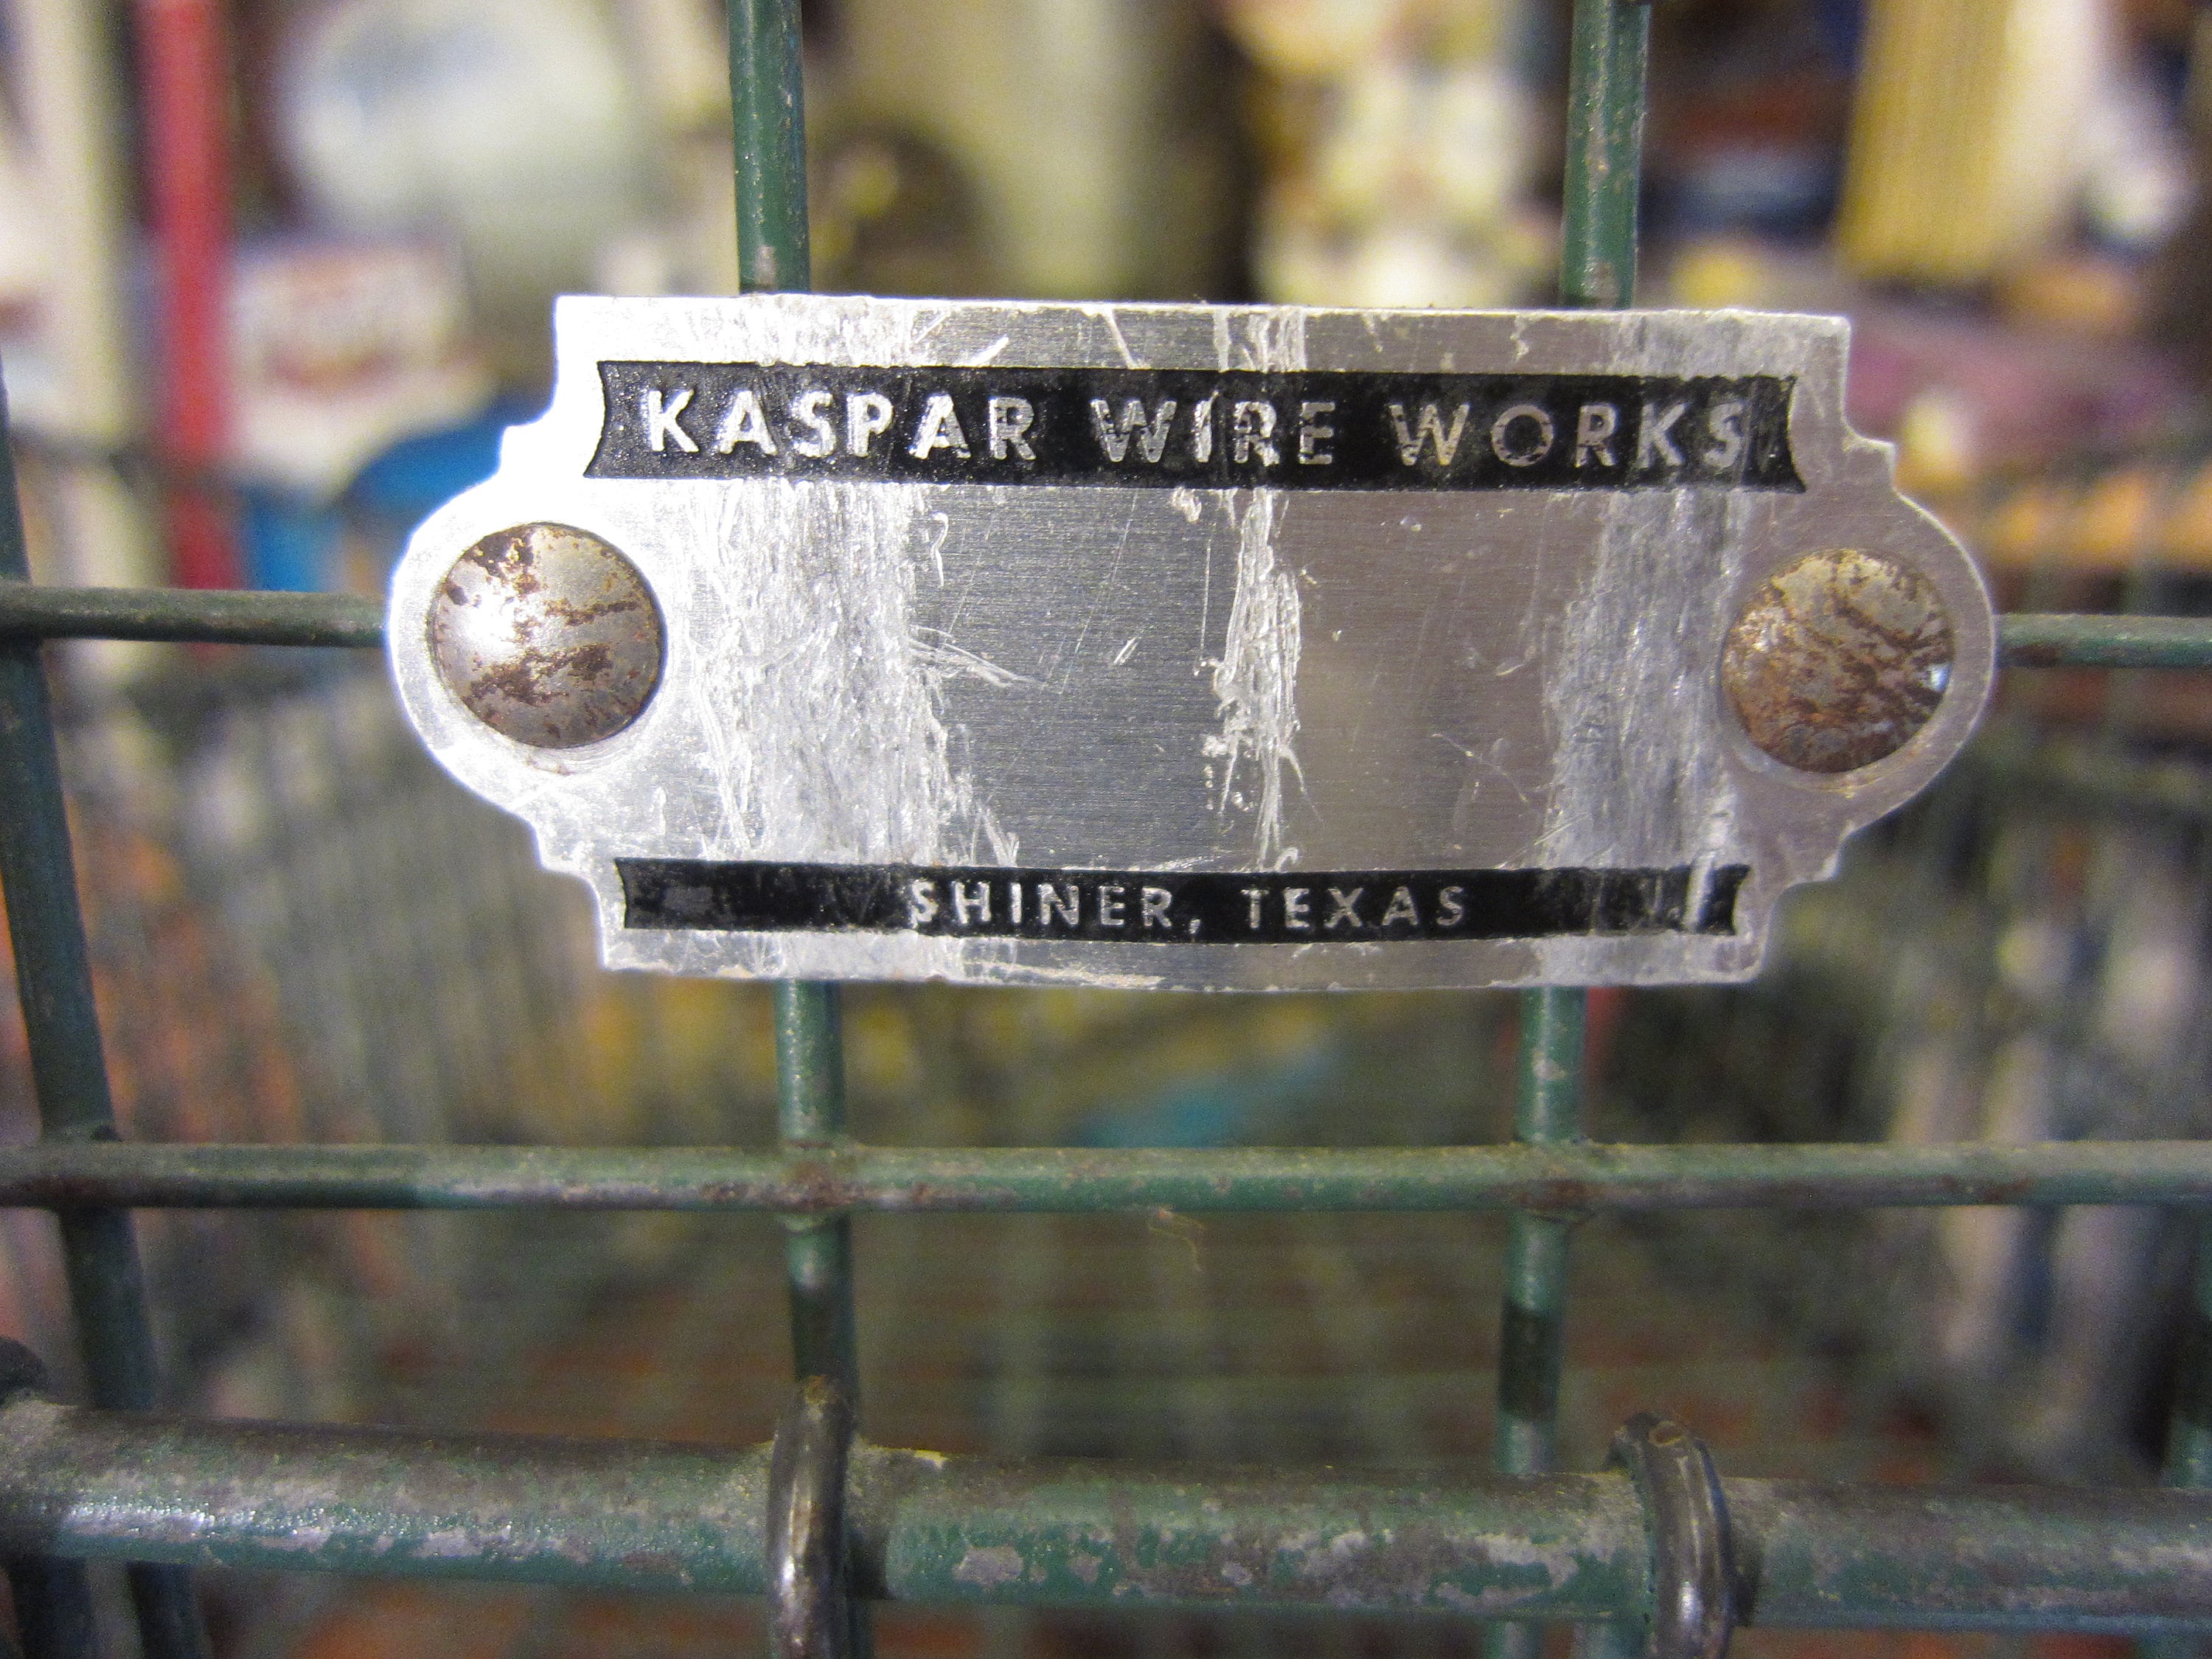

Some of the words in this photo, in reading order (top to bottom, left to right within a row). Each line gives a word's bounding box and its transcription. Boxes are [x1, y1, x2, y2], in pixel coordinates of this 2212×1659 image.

[646, 388, 1036, 461] KASPAR
[1090, 397, 1335, 466] WIRE
[1388, 400, 1747, 468] WORKS
[908, 880, 1201, 935] SHINER,
[1241, 885, 1465, 929] TEXAS
